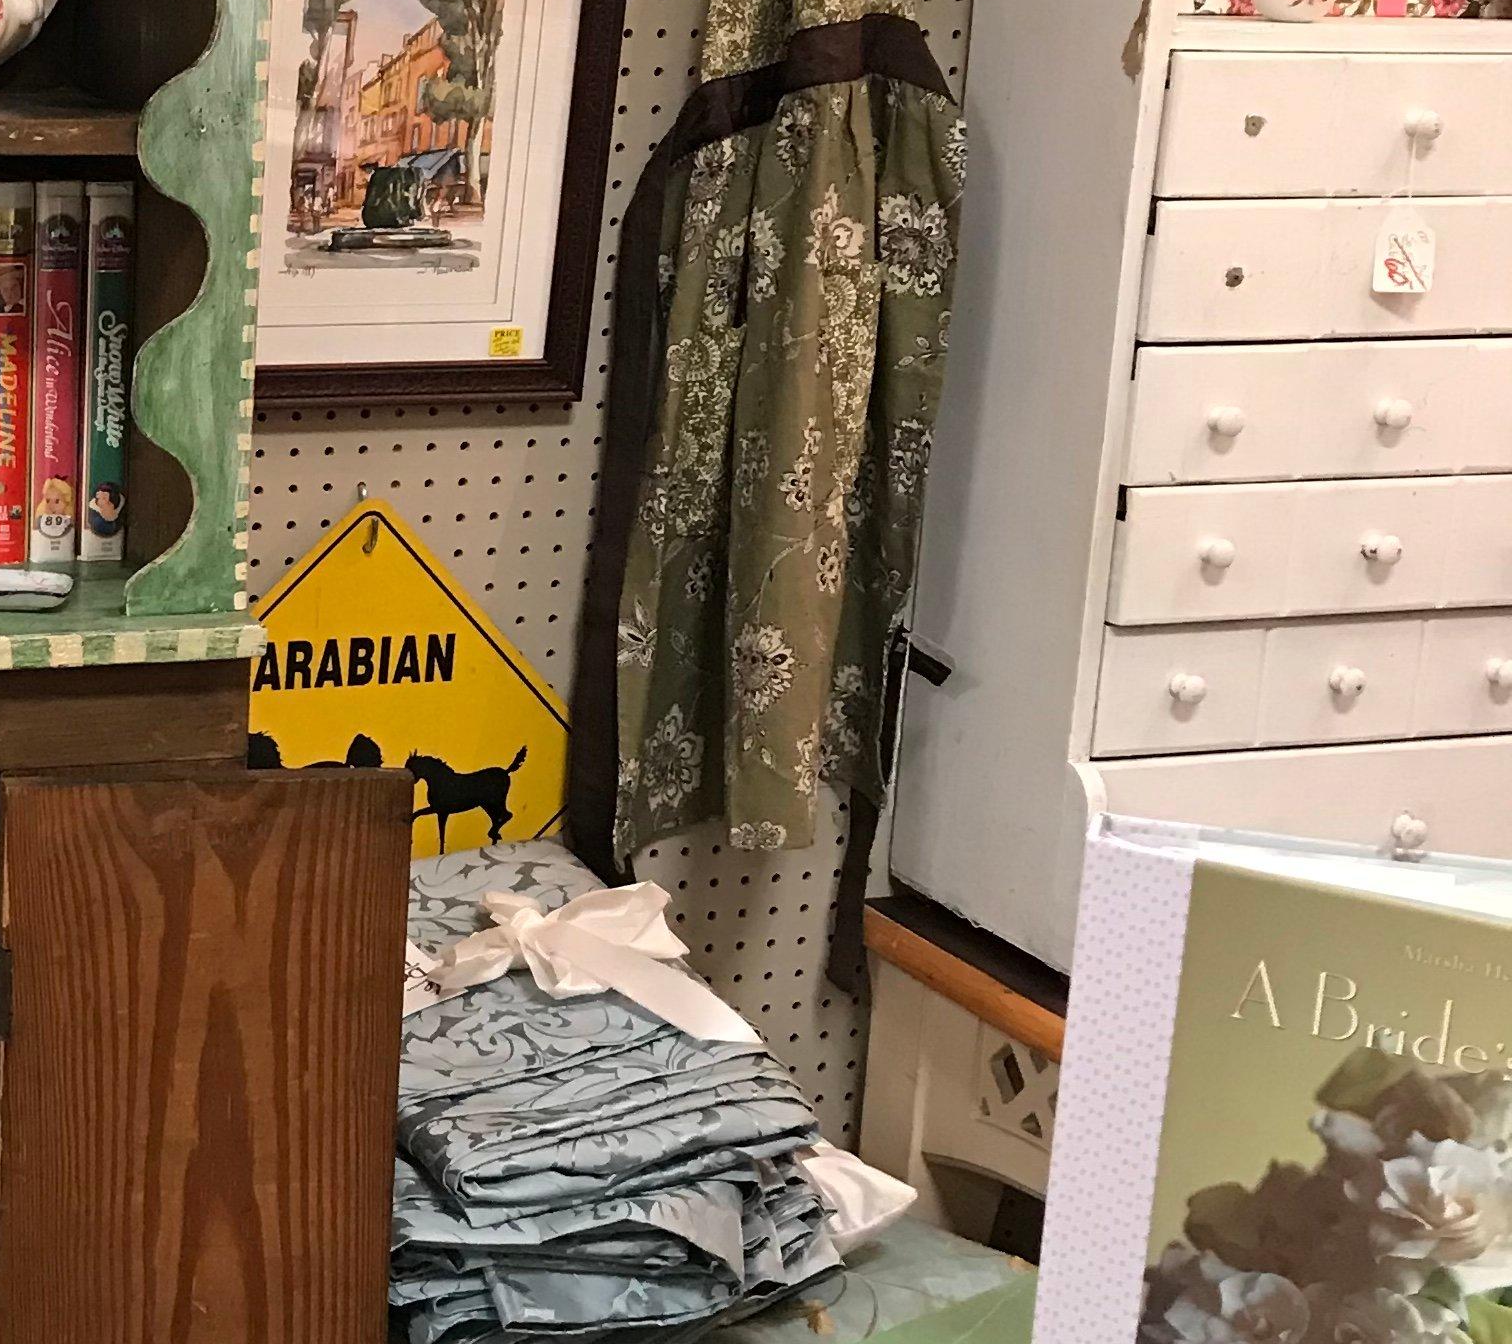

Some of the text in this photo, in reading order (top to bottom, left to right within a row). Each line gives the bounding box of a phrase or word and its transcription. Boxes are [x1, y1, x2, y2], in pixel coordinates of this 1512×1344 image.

[45, 290, 73, 375] Alice
[98, 310, 128, 383] Snow
[105, 383, 126, 448] White
[252, 633, 456, 692] ARABIAN
[1403, 944, 1475, 974] Marsha
[1230, 960, 1285, 1029] A
